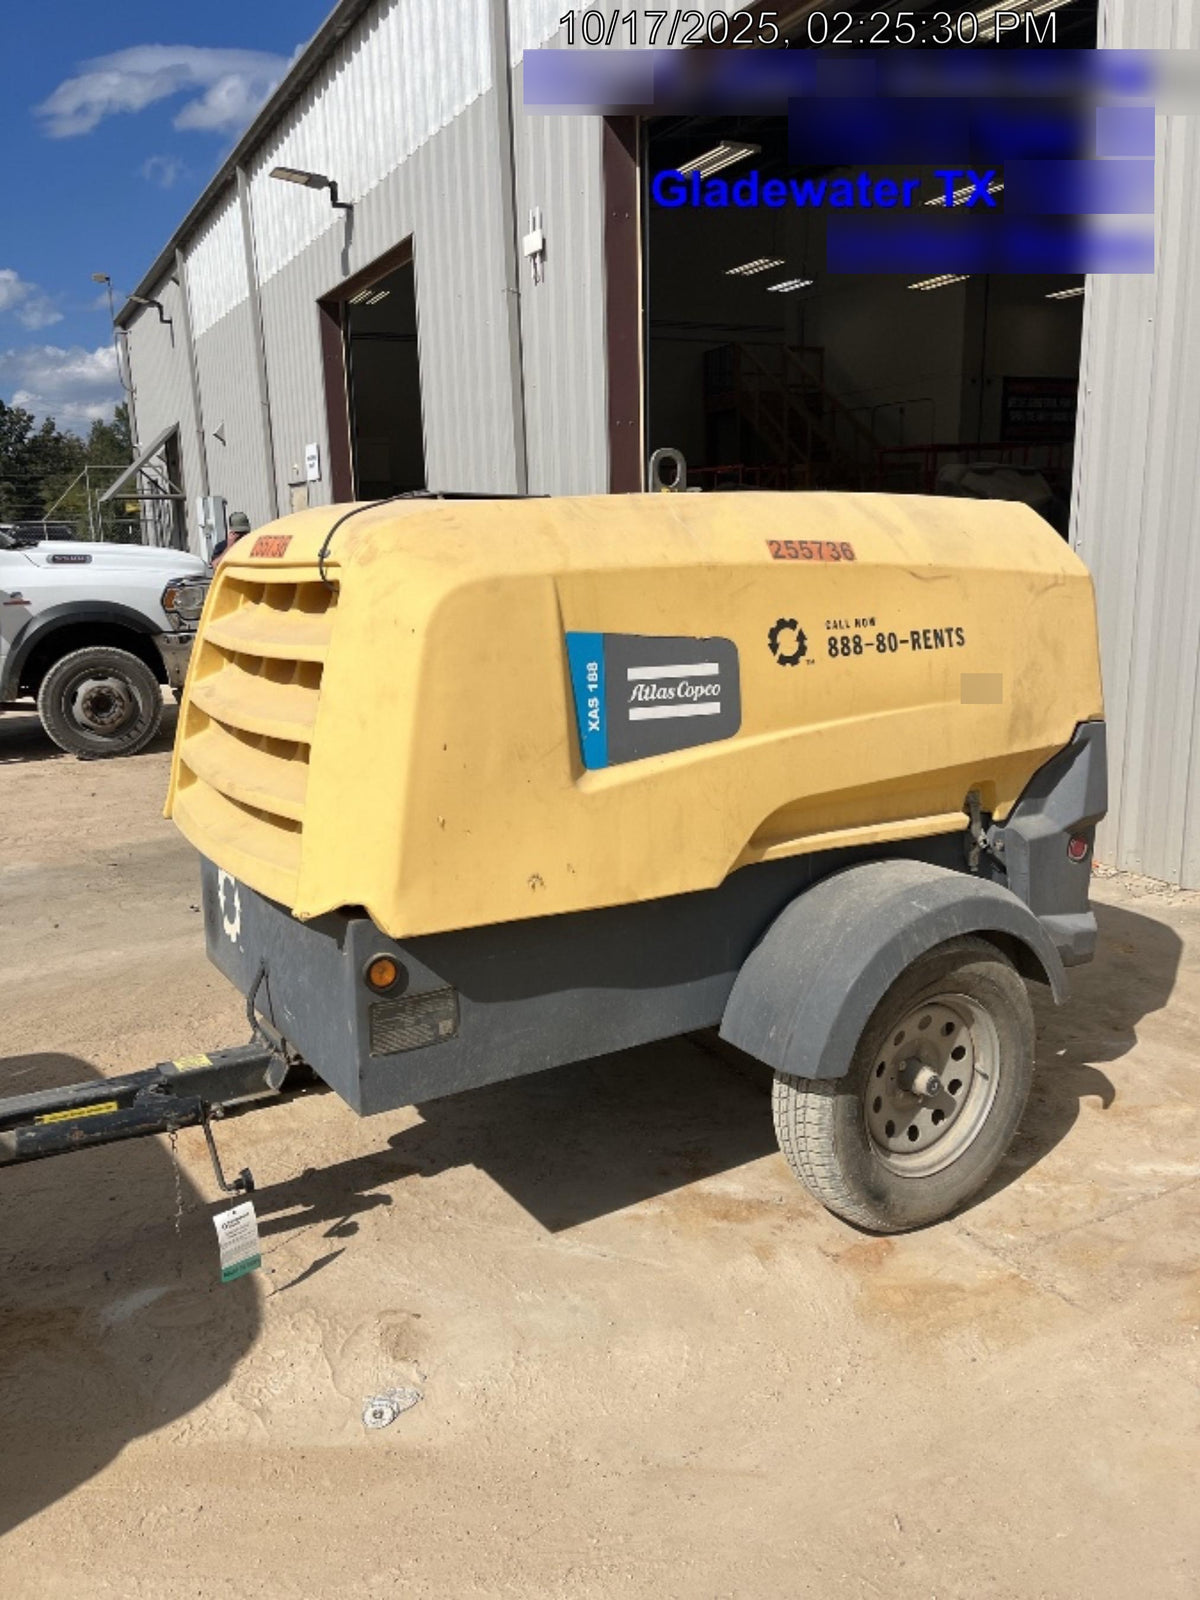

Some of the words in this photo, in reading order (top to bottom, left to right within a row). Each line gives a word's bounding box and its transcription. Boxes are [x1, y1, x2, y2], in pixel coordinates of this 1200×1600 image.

[768, 540, 856, 561] 255736
[826, 619, 850, 630] CALL
[854, 617, 876, 628] NOW
[828, 627, 966, 657] 888-80-RENTS
[586, 661, 599, 692] 188
[628, 683, 676, 703] Atlas
[676, 680, 721, 701] Copco
[587, 697, 600, 731] XAS
